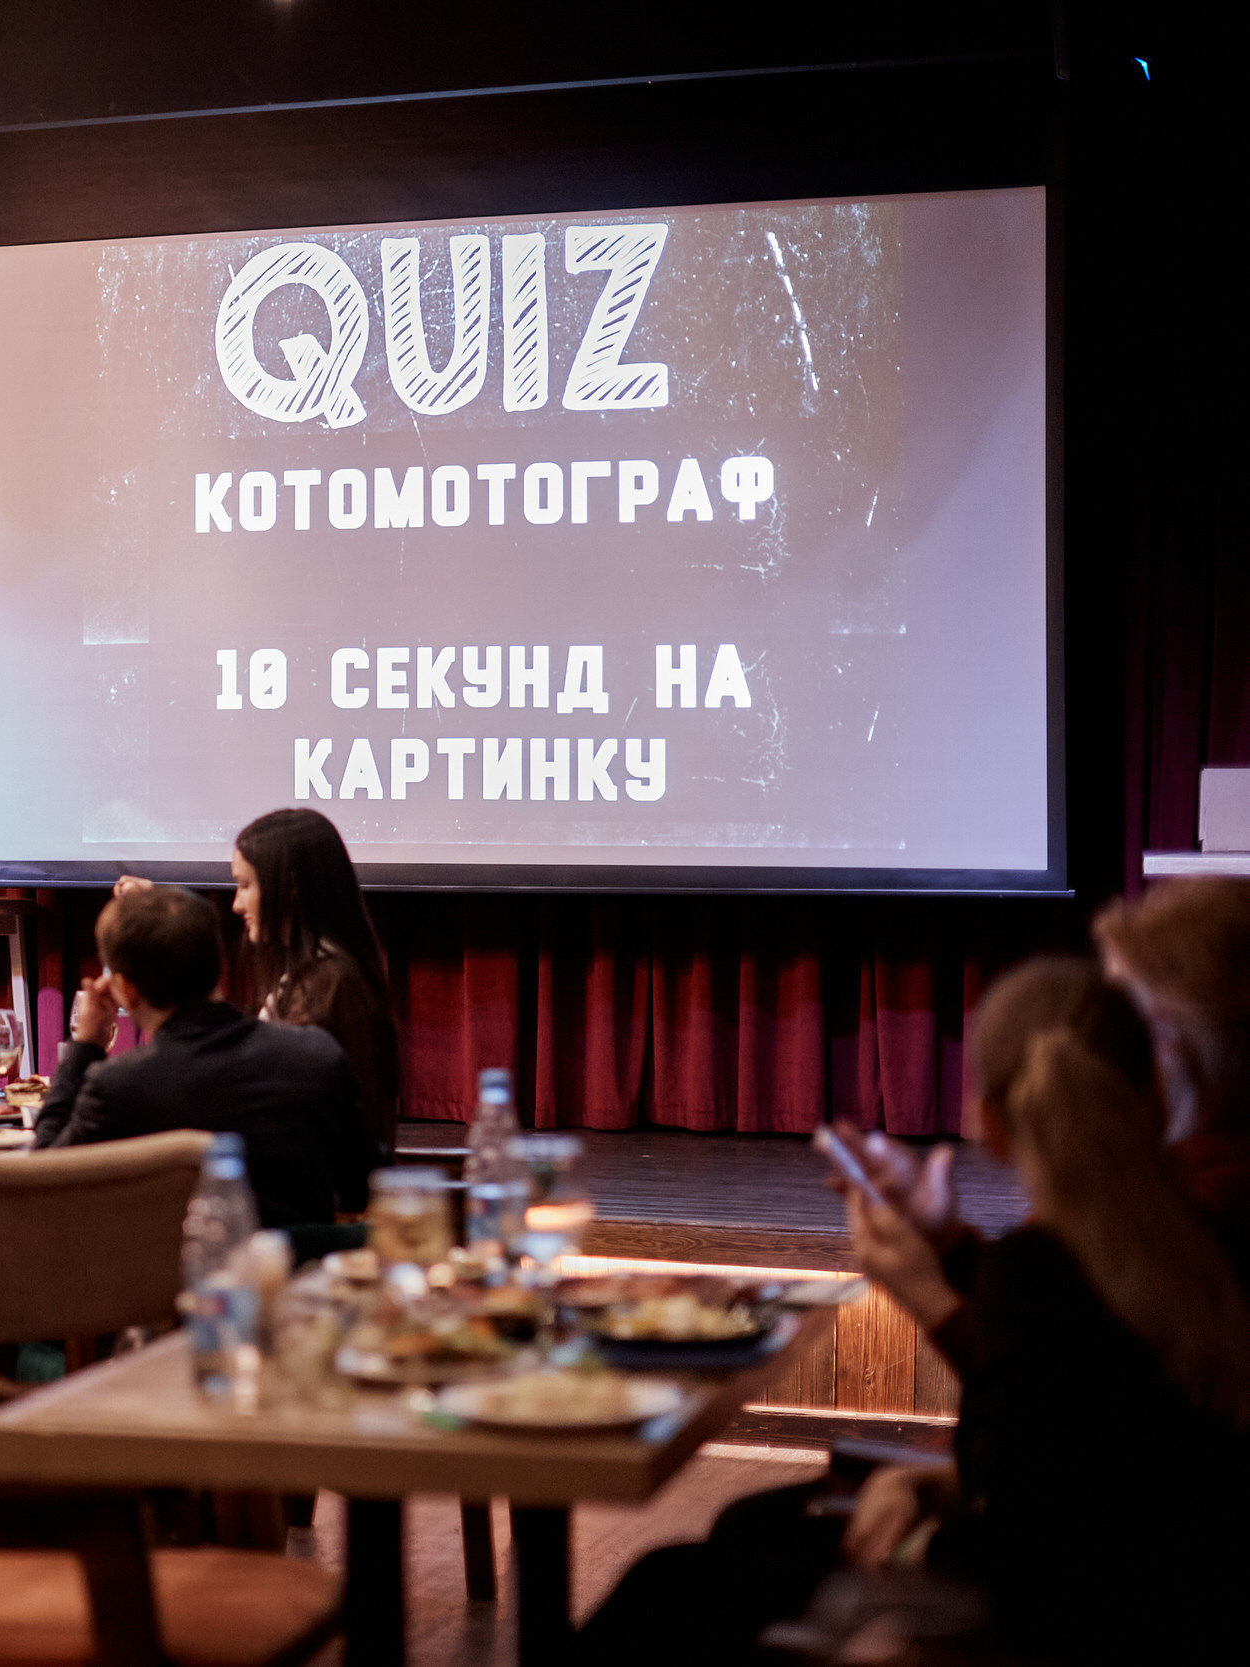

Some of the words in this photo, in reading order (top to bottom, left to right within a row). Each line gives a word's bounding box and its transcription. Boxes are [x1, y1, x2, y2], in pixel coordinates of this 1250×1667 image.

[214, 222, 669, 430] QUIZ
[195, 456, 774, 534] КОТОМОТОГРАФ
[216, 648, 287, 710] 10
[331, 645, 609, 714] СЕКУНД
[655, 644, 752, 708] НА
[294, 737, 666, 801] КАРТИНКУ
